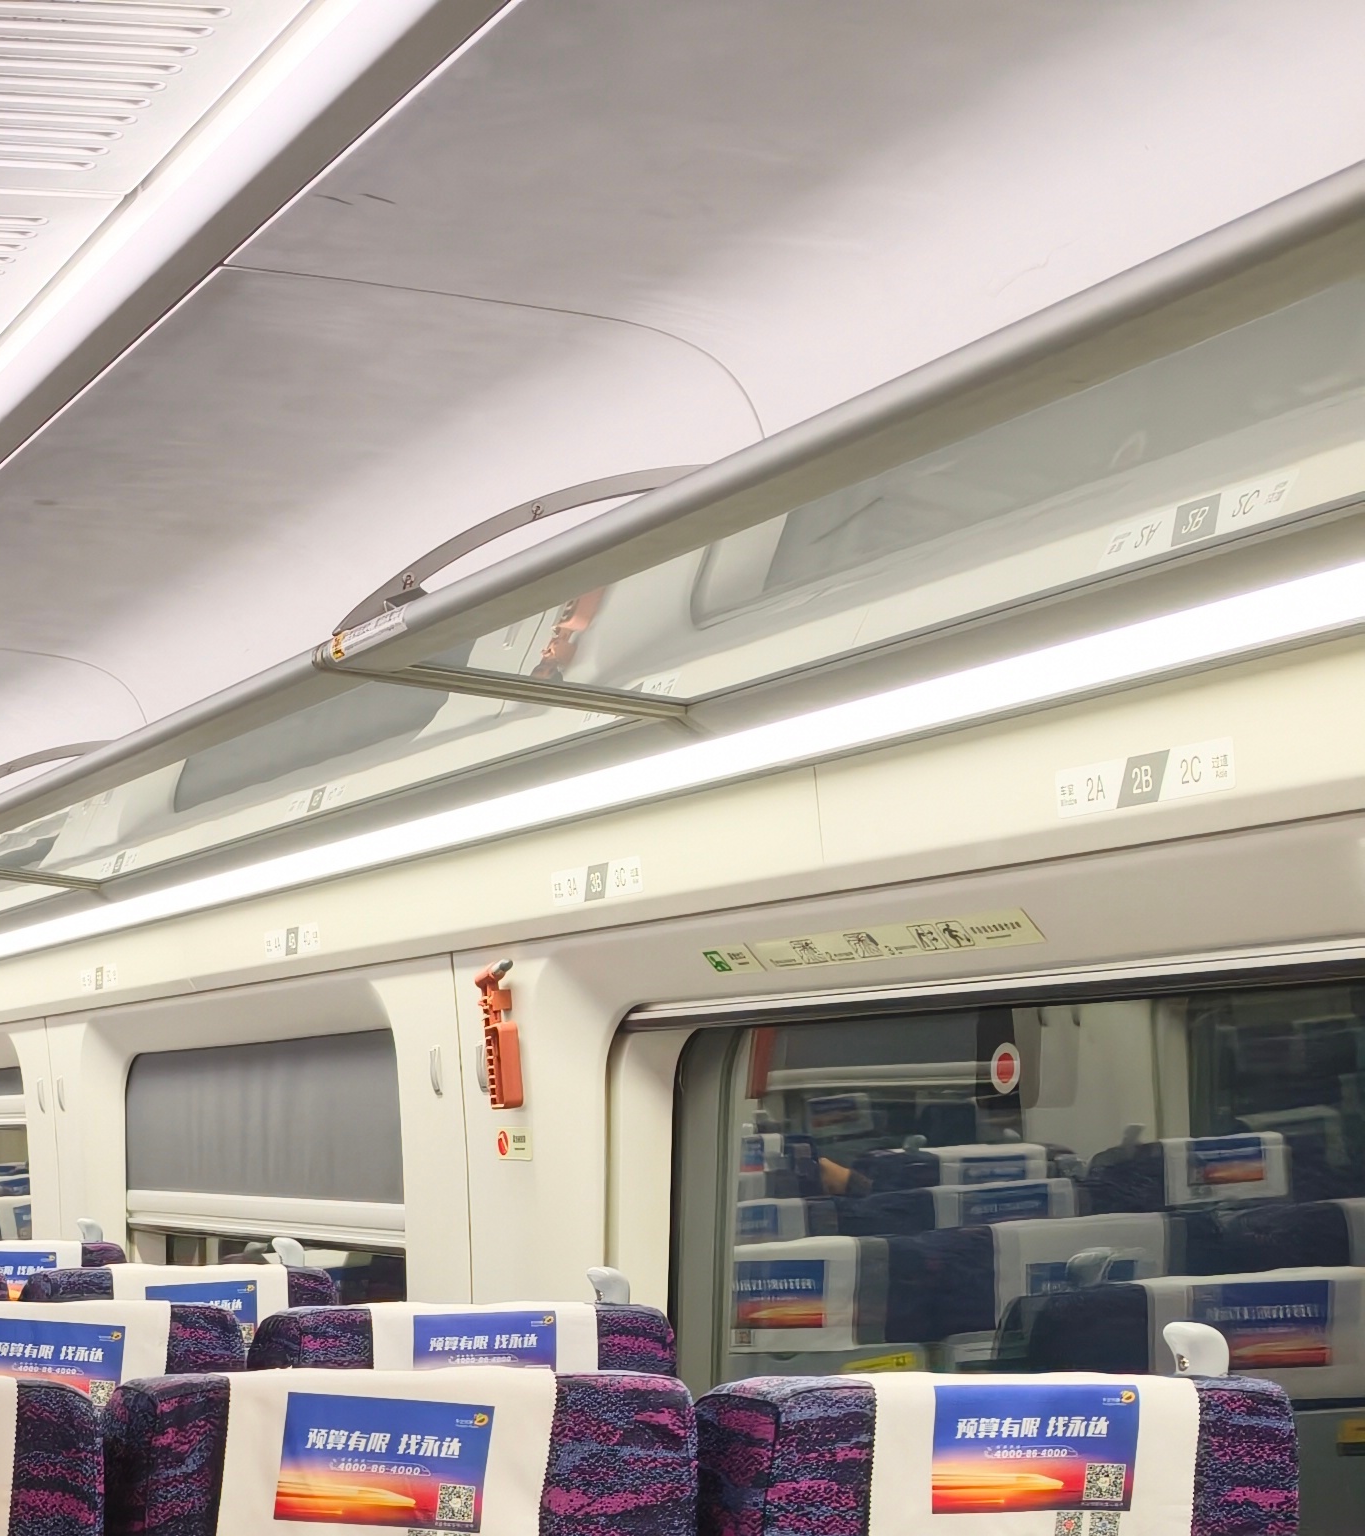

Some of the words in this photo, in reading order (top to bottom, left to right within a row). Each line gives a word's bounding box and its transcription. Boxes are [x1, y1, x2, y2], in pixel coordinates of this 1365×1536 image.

[1086, 775, 1105, 802] 2A
[1132, 765, 1153, 794] 2B
[1180, 756, 1202, 784] 2C
[590, 872, 602, 892] 3B
[430, 1335, 488, 1351] 预算有限
[494, 1332, 537, 1349] 找永达
[60, 1345, 103, 1362] 找永达
[955, 1418, 1040, 1439] 预算有限
[1046, 1417, 1109, 1438] 找永达
[305, 1429, 390, 1453] 预算有限
[397, 1434, 461, 1458] 找永达
[995, 1448, 1068, 1458] 4000-86-4000
[338, 1462, 421, 1475] 4000-86-4000
